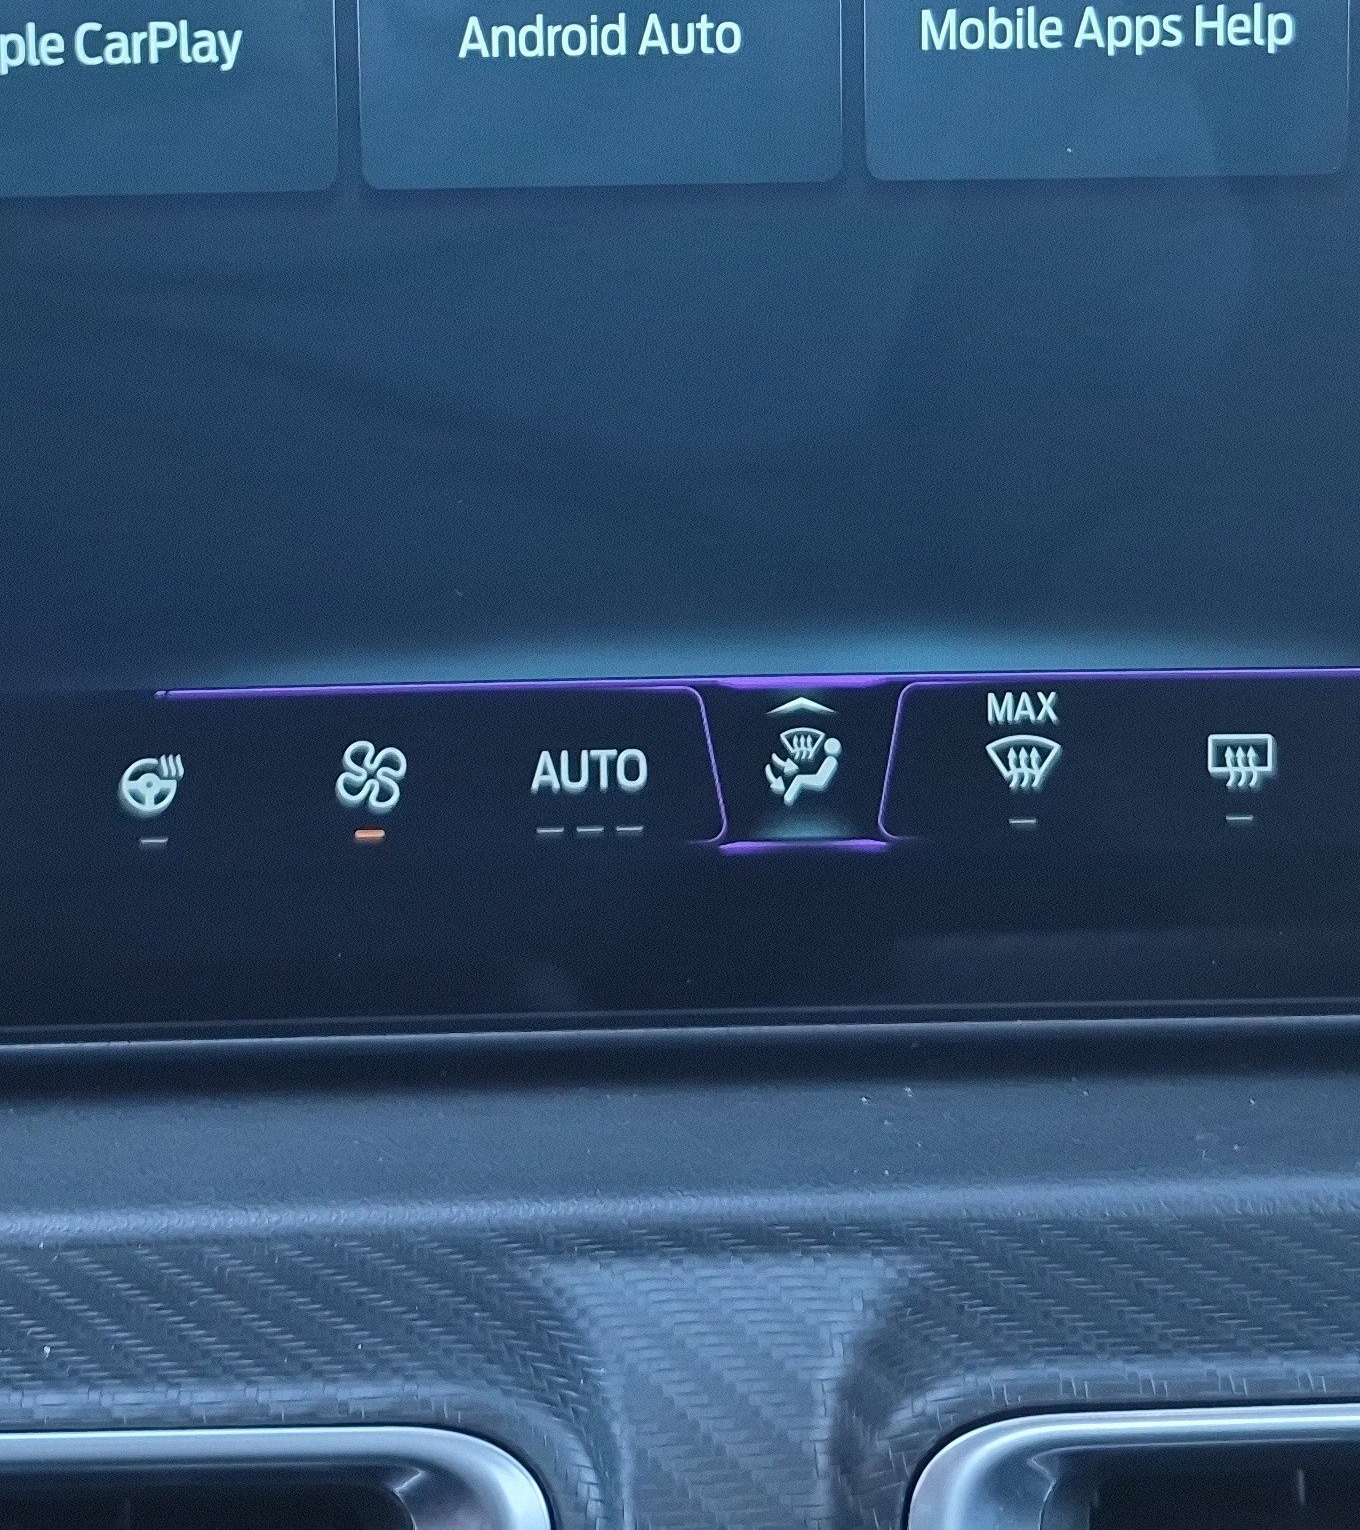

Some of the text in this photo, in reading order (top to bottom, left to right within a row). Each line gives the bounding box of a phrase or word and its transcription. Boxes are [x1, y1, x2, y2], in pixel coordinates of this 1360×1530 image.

[74, 19, 243, 72] CarPlay
[458, 12, 743, 60] Android Auto
[920, 2, 1295, 57] Mobile Apps Help
[985, 690, 1060, 726] MAX
[530, 747, 649, 794] AUTO
